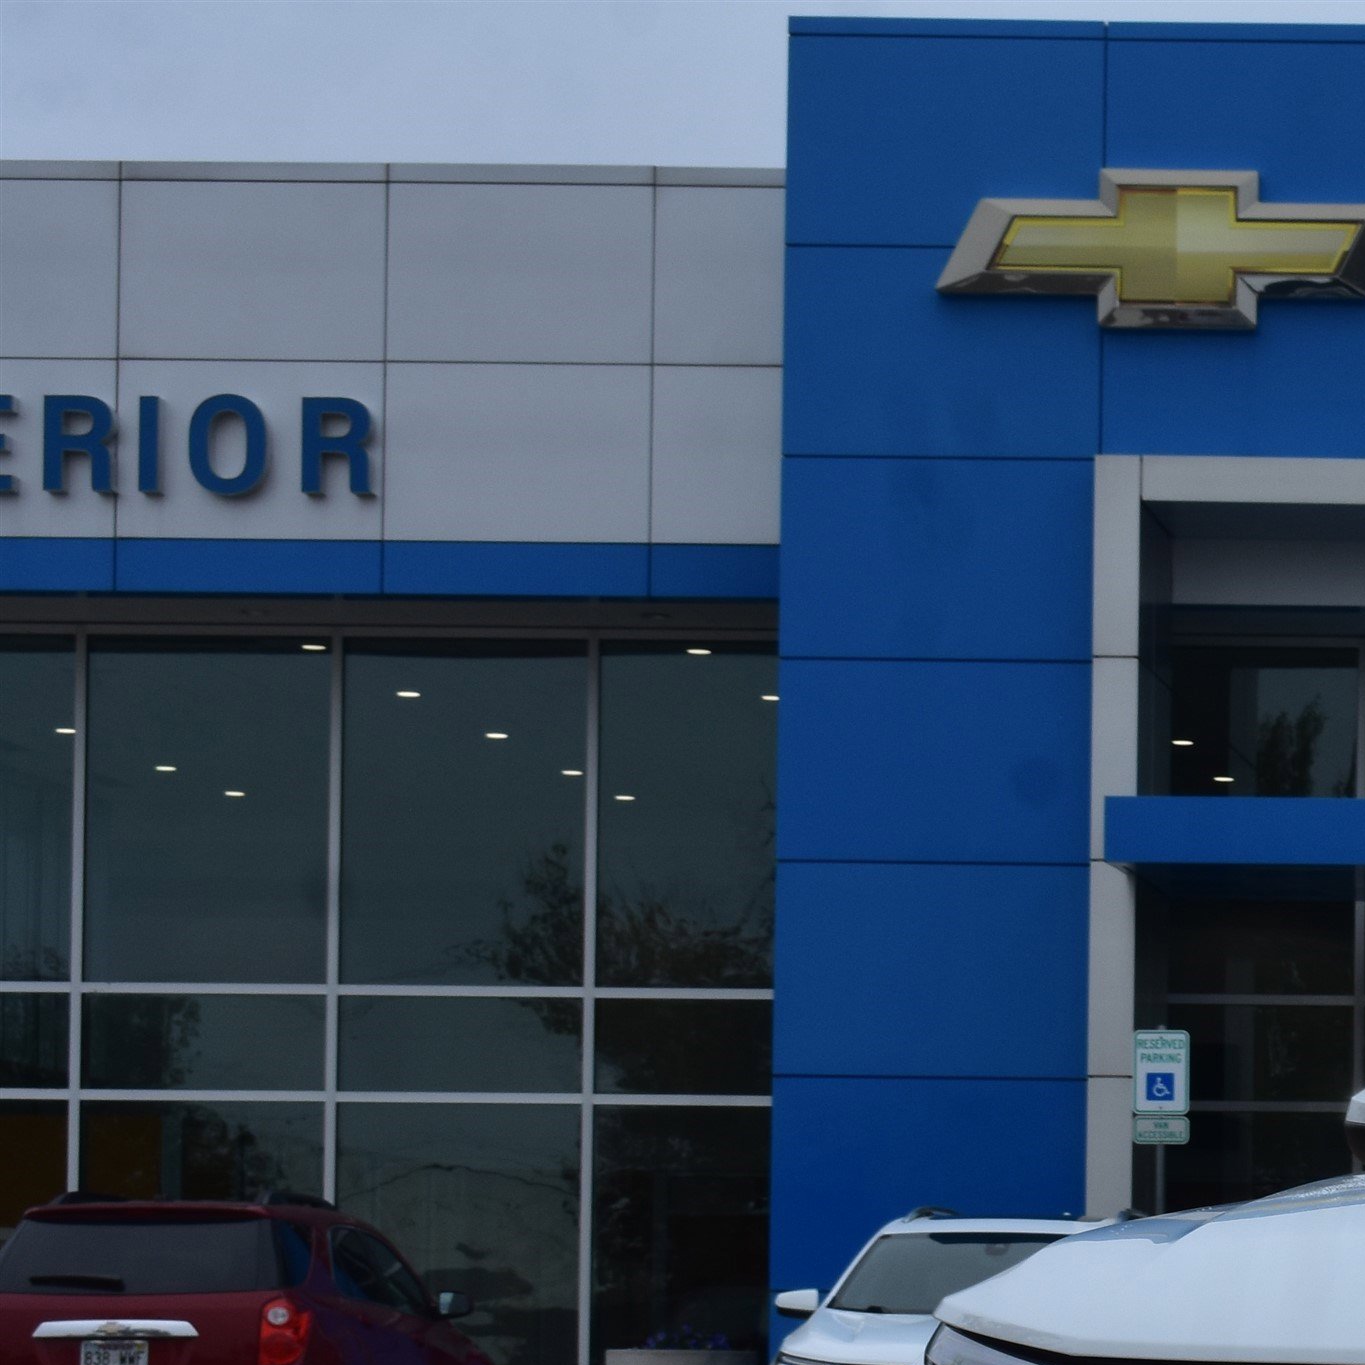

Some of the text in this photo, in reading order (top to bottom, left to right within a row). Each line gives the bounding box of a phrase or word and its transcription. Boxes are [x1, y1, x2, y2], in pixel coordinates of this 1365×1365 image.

[0, 395, 378, 497] RIOR
[1137, 1039, 1184, 1049] RESERVED
[1140, 1052, 1182, 1063] PARKING
